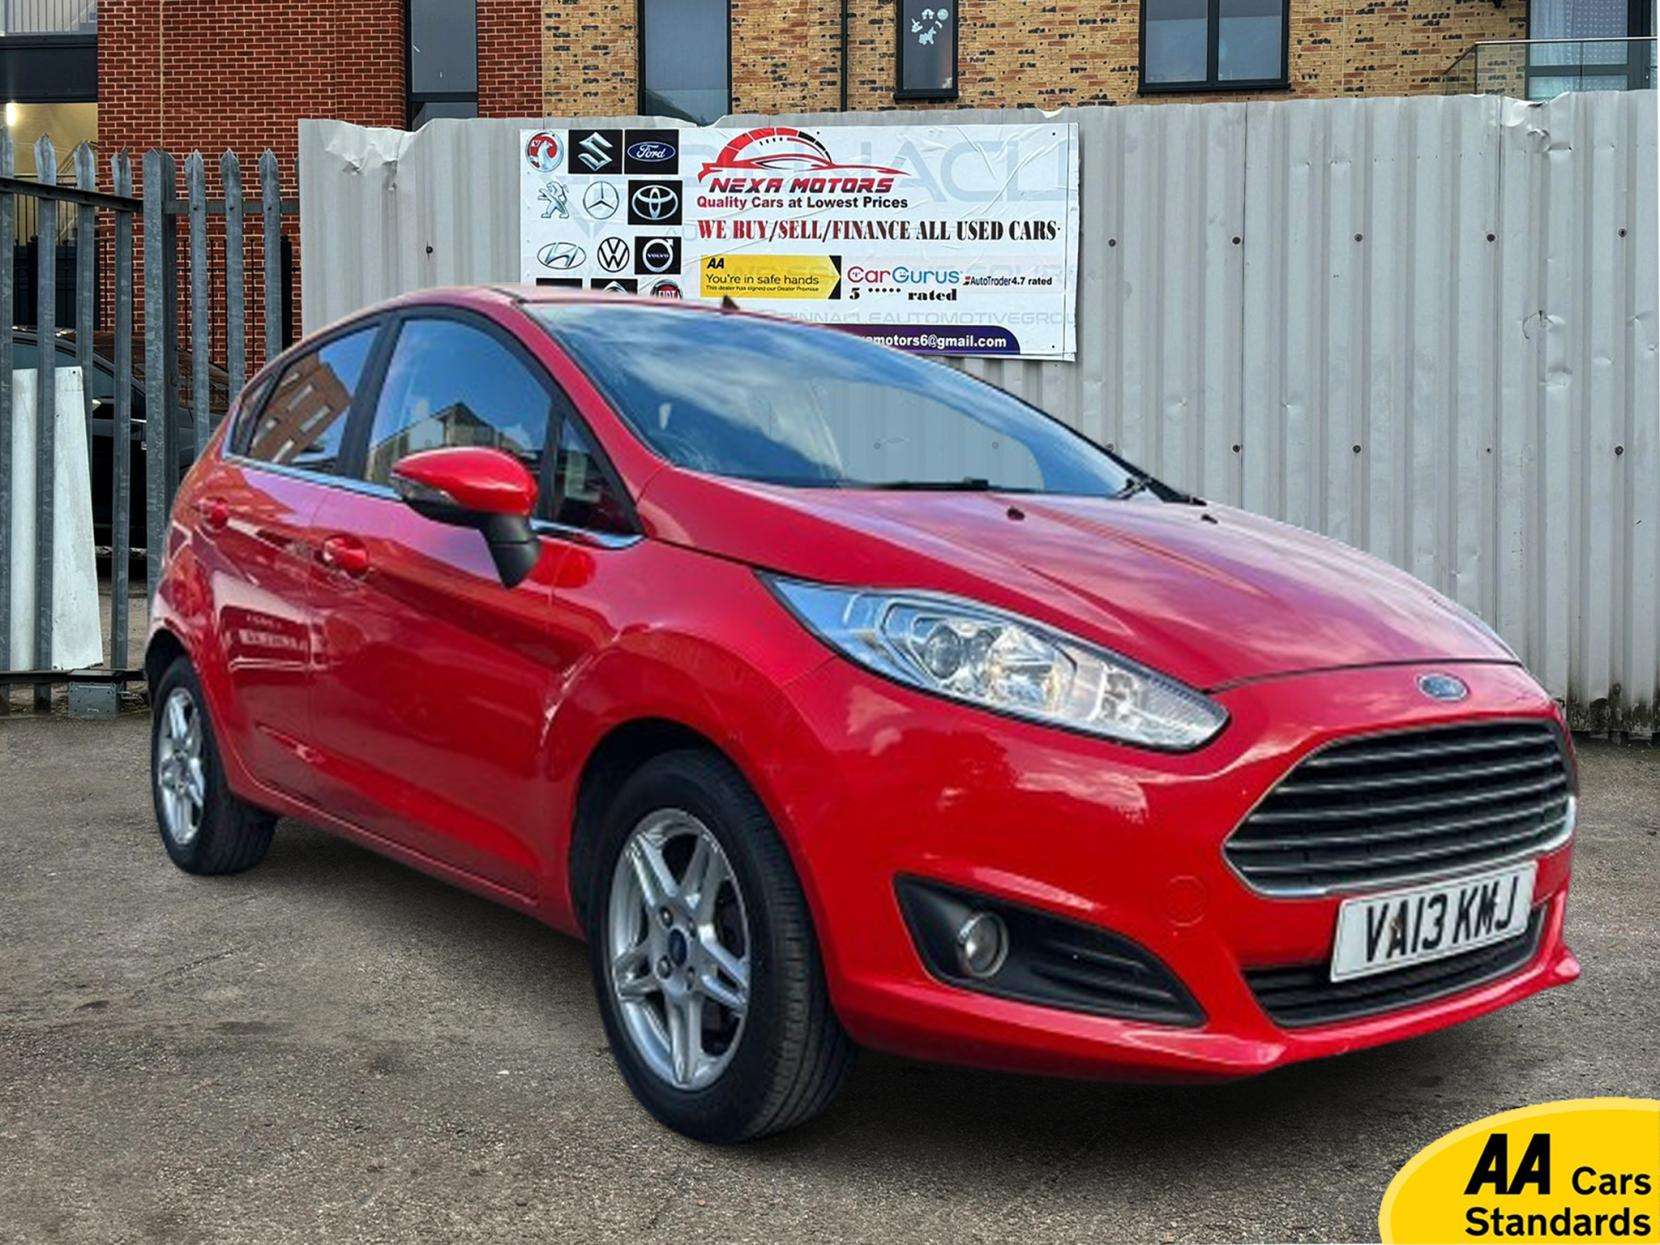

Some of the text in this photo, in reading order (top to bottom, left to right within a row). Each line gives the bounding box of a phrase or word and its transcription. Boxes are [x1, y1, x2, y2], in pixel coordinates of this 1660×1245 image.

[636, 145, 666, 159] Ford
[709, 178, 895, 194] NEXA MOTORS
[696, 196, 908, 210] Quality Cars at Lowest Prices
[697, 220, 727, 239] WE
[916, 220, 950, 240] ALL
[956, 221, 1004, 241] USED
[1009, 220, 1057, 241] CARS
[707, 258, 724, 269] AA
[706, 274, 819, 285] You're in safe hands
[847, 266, 960, 284] CarGurus
[1028, 277, 1052, 286] rated
[849, 287, 957, 301] 5 rated
[1366, 875, 1519, 962] VA13 KMJ
